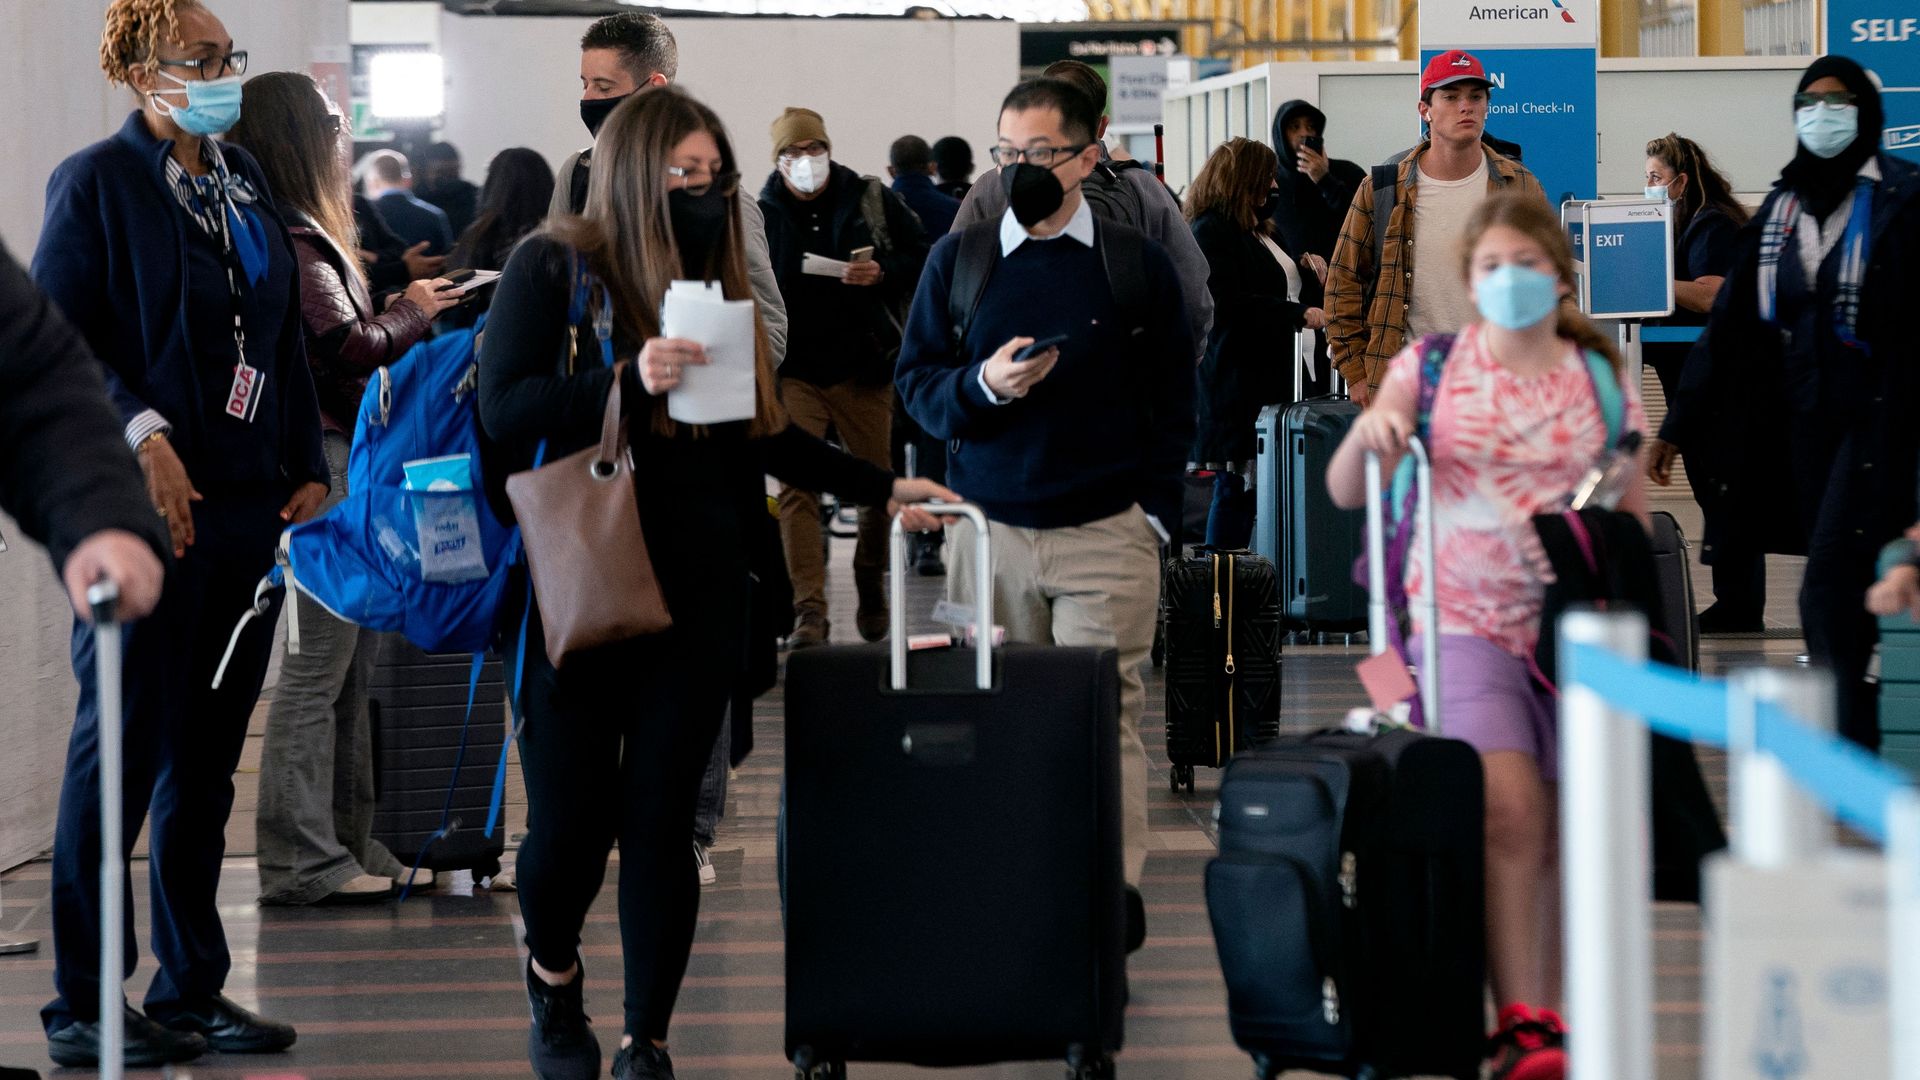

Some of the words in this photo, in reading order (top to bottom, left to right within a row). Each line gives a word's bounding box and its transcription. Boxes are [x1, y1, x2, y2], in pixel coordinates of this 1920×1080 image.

[1469, 5, 1549, 20] American
[1487, 102, 1518, 114] ional
[1522, 102, 1575, 114] Check-In
[1627, 209, 1655, 217] American
[1596, 234, 1625, 247] EXIT
[229, 369, 254, 416] DCA
